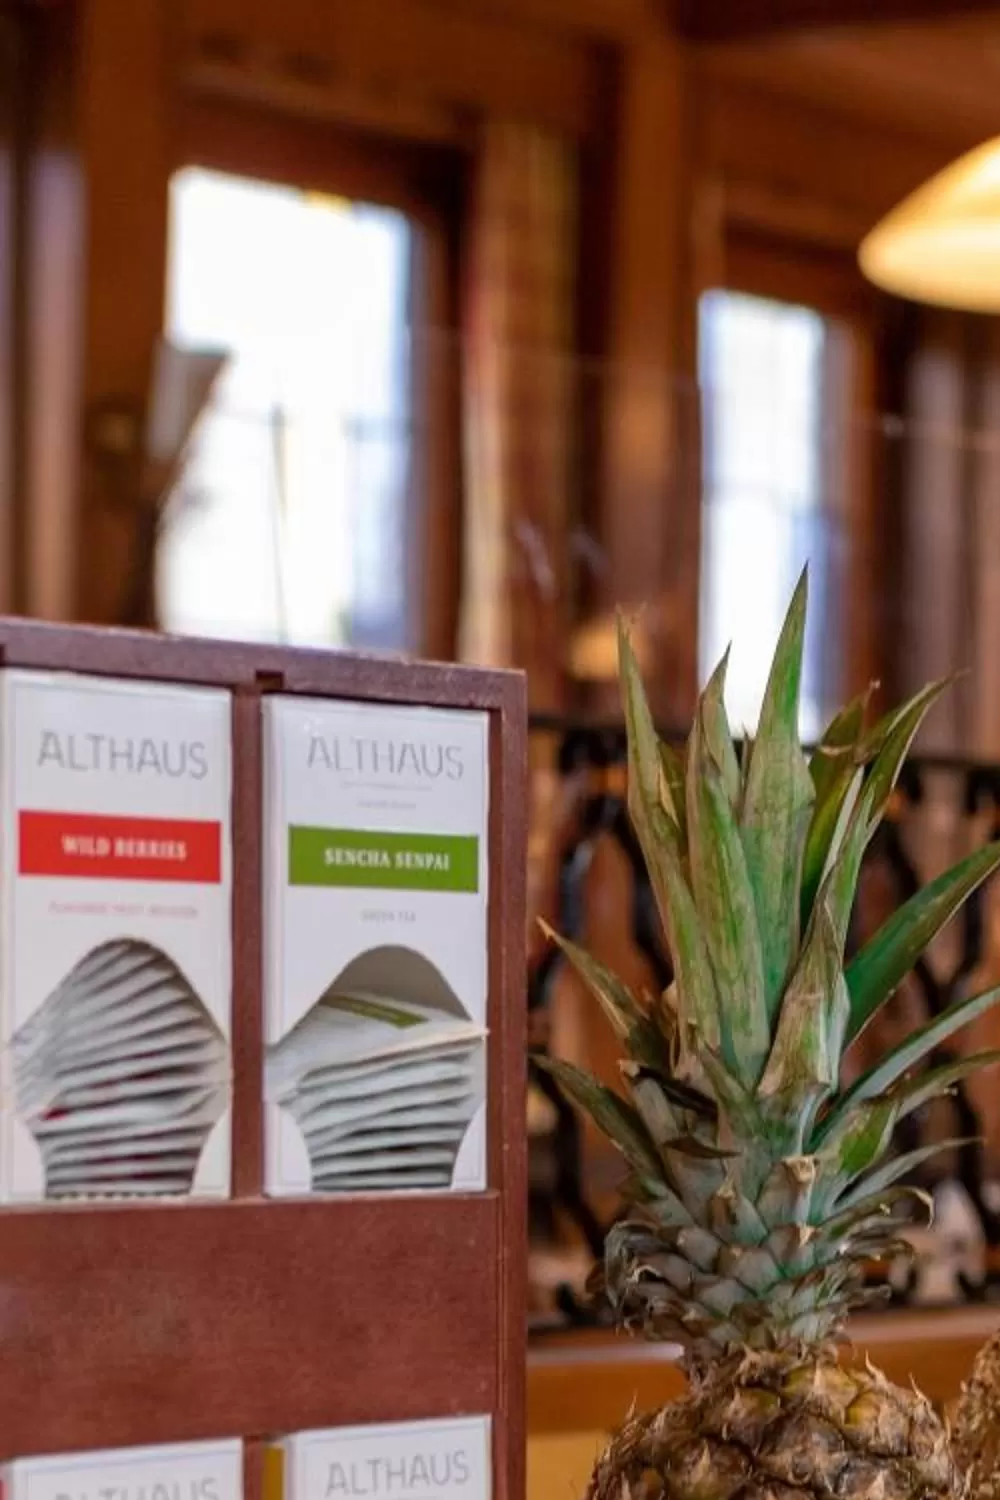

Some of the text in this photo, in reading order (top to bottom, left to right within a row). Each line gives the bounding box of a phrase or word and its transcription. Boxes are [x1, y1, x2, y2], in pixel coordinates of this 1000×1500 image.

[38, 728, 208, 780] ALTHAUS
[307, 735, 464, 781] ALTHAUS
[325, 847, 450, 872] SENCHA SENPAI
[325, 1449, 470, 1498] ALTHAUS
